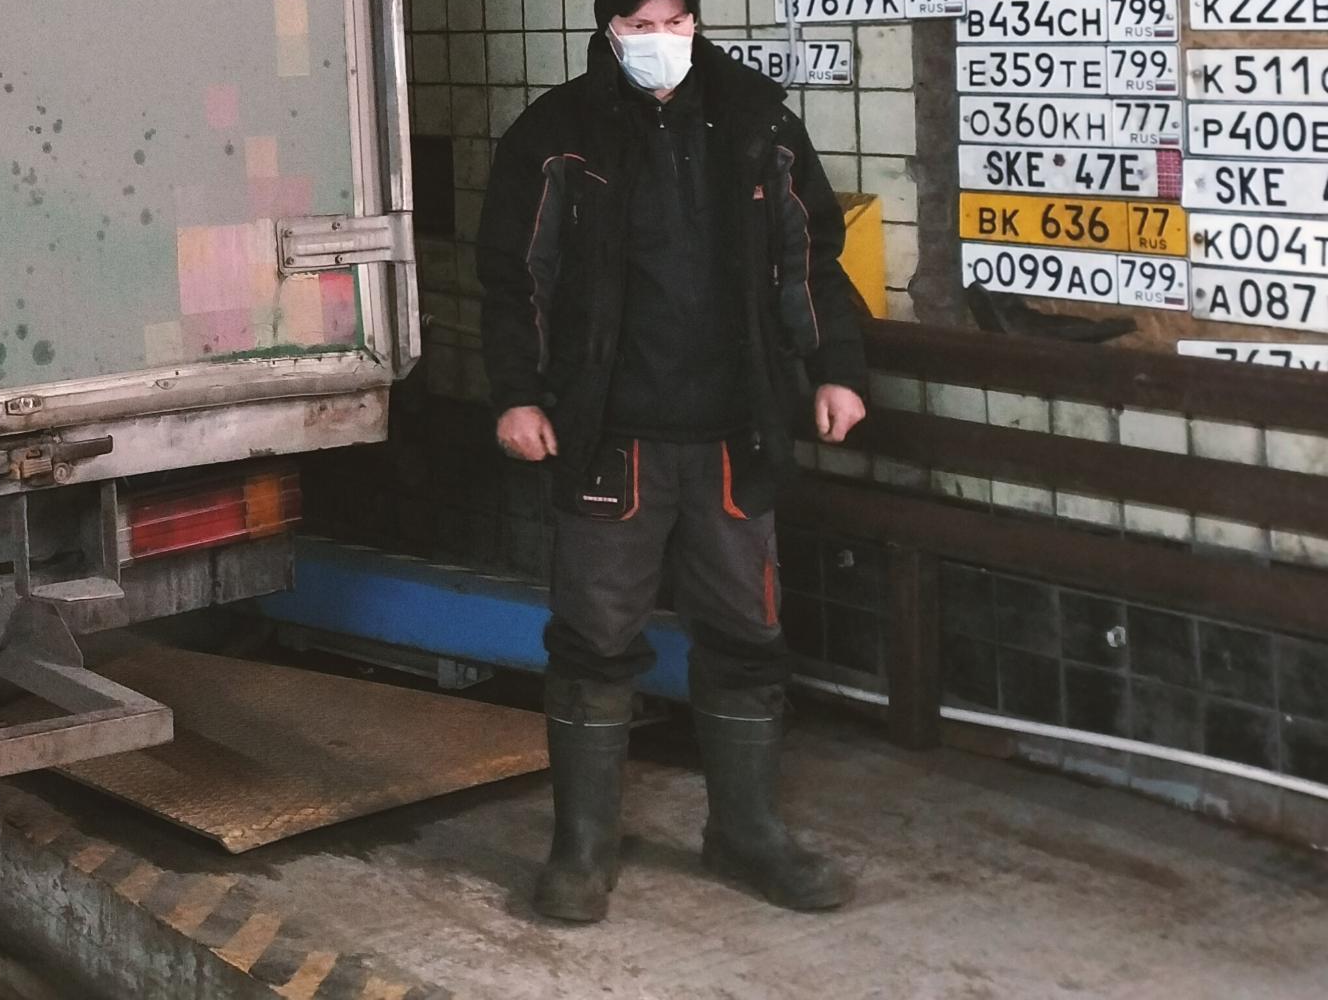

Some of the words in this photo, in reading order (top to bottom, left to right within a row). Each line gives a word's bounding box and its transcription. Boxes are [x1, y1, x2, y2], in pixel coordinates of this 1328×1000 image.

[919, 3, 944, 13] RUS
[967, 0, 1101, 37] В434СН
[1125, 27, 1152, 37] RUS
[809, 44, 840, 69] 77
[969, 52, 1101, 88] Е359ТЕ
[1111, 50, 1167, 78] 799
[809, 71, 832, 80] RUS
[1126, 80, 1154, 91] RUS
[1116, 103, 1170, 132] 777
[1130, 133, 1158, 144] RUS
[986, 150, 1045, 187] SKE
[1075, 153, 1139, 191] 47E
[1215, 166, 1287, 206] SKE
[1041, 203, 1110, 243] 636
[1132, 206, 1169, 237] 77
[1139, 237, 1167, 249] RUS
[1120, 259, 1176, 291] 799
[1135, 291, 1163, 302] RUS
